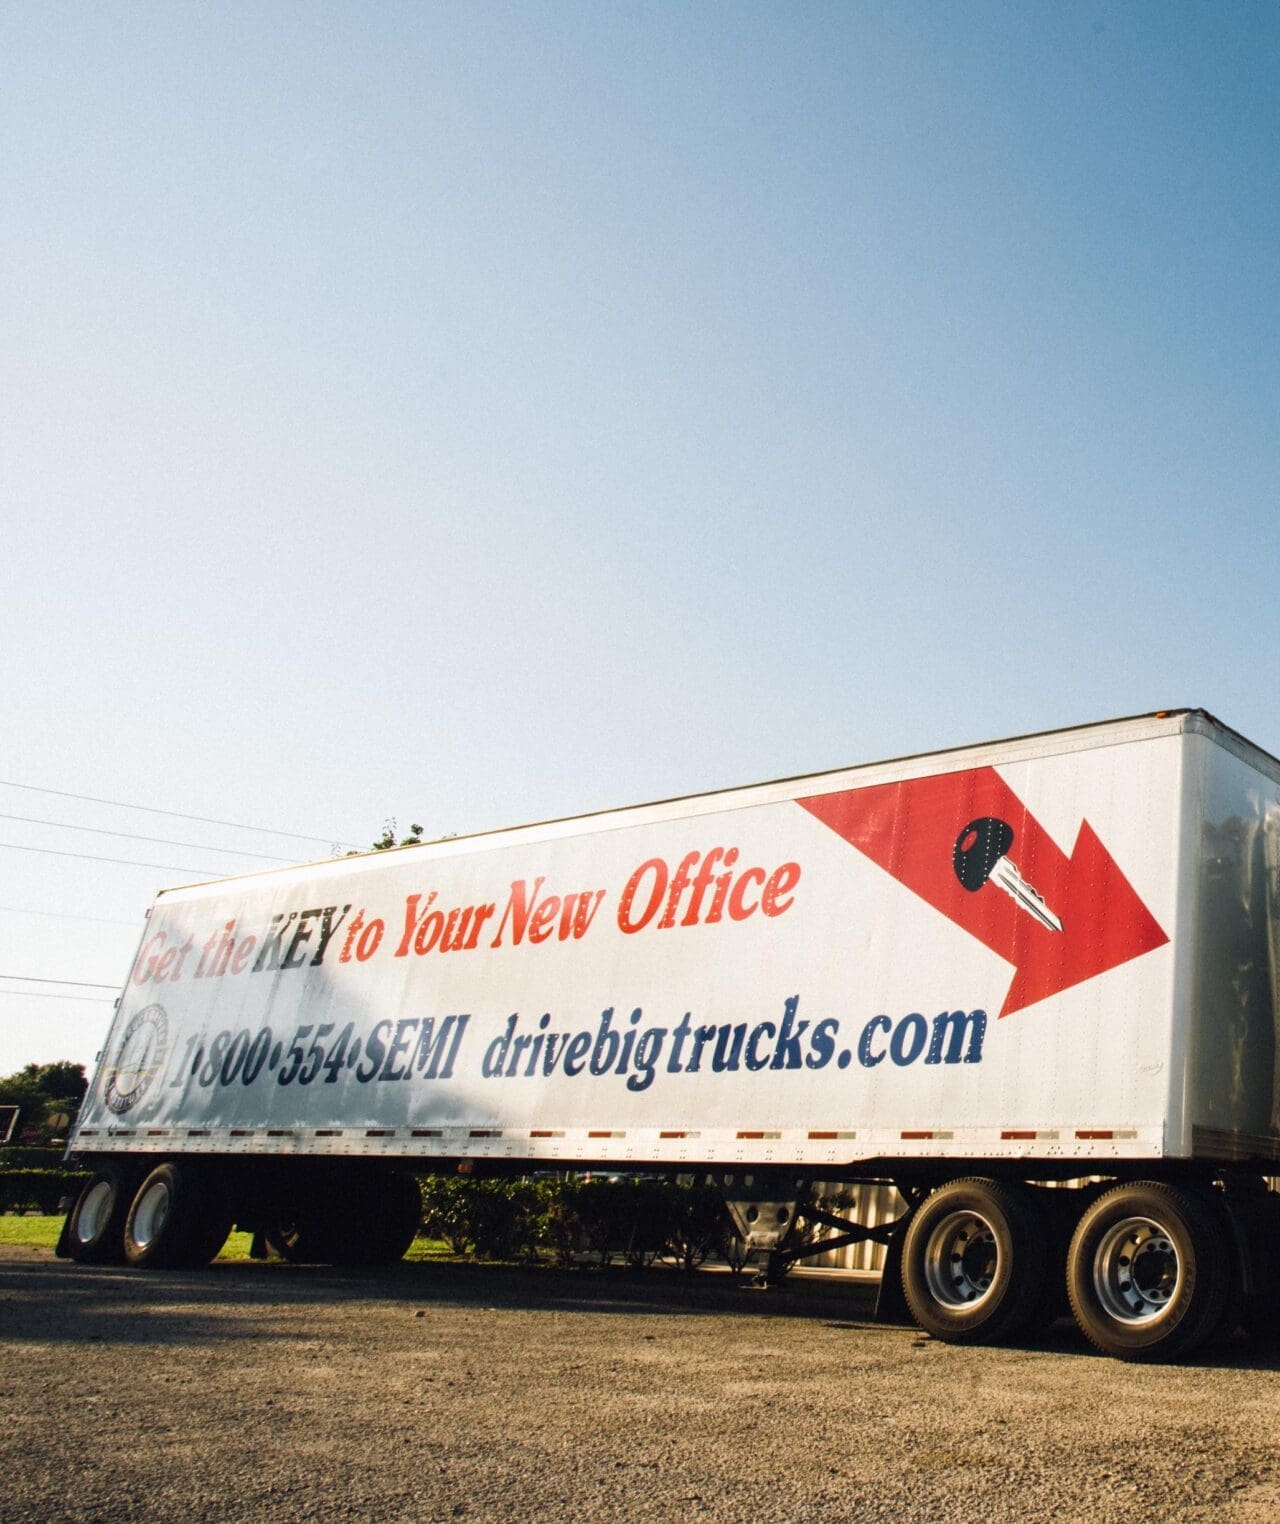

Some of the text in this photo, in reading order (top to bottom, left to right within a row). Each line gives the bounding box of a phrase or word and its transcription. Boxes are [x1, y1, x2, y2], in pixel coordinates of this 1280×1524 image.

[132, 846, 802, 987] Get the KEY to Your New Office
[481, 994, 988, 1092] drivebigtrucks.com
